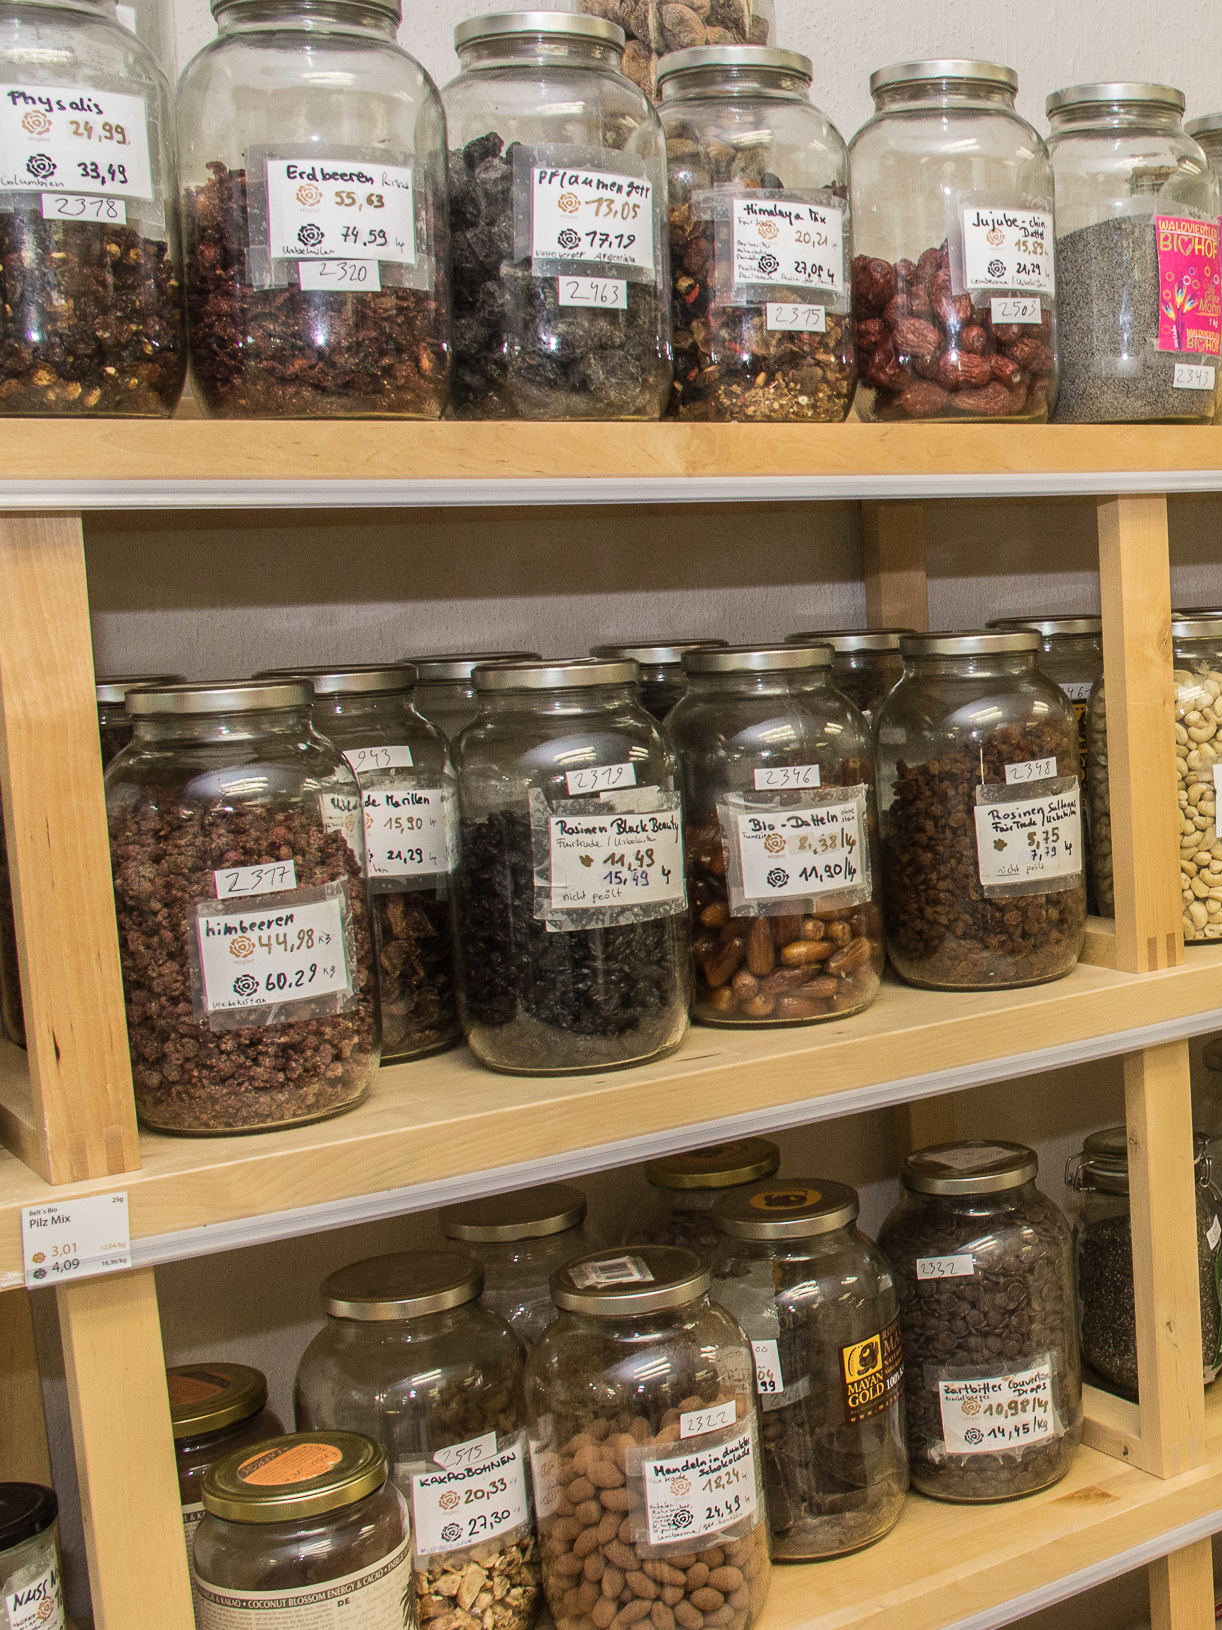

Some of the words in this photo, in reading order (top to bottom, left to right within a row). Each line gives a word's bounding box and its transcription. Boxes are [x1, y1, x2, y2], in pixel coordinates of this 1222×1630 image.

[7, 91, 103, 115] Physalis
[77, 161, 128, 186] 33,49
[286, 164, 374, 185] Erdbeeren
[55, 198, 119, 219] 2378
[334, 190, 384, 211] 55,63
[585, 197, 641, 220] 13,05
[744, 204, 804, 226] Himalaya
[973, 211, 1019, 232] Jujube
[585, 230, 636, 249] 17,19
[795, 230, 827, 248] 20,21
[1159, 220, 1217, 240] WALDVIERTLER
[319, 262, 367, 282] 2320
[566, 281, 619, 304] 2463
[776, 307, 821, 325] 2315
[999, 300, 1036, 316] 2503
[1199, 299, 1220, 314] Mohn
[574, 767, 624, 788] 2319
[766, 767, 810, 785] 2346
[385, 792, 430, 808] Marillen
[988, 806, 1045, 821] Rosinen
[384, 816, 423, 834] 15,90
[555, 820, 608, 836] Rosinen
[611, 817, 647, 835] Black
[649, 814, 680, 843] Beauty
[1027, 827, 1060, 850] 5,75
[387, 848, 423, 864] 21,29
[602, 852, 656, 871] 11,49
[226, 866, 290, 893] 2317
[997, 865, 1020, 875] nicht
[562, 891, 587, 902] nicht
[258, 928, 316, 955] 44,98
[29, 1215, 49, 1229] Pilz
[51, 1213, 71, 1225] Mix
[51, 1242, 78, 1258] 3,01
[52, 1258, 81, 1274] 4,09
[101, 1257, 127, 1267] 16,36/kg
[848, 1370, 883, 1395] MAYAN
[944, 1382, 1002, 1395] Zartbitter
[1013, 1382, 1046, 1396] Drops
[848, 1382, 884, 1407] GOLD
[420, 1452, 516, 1487] KAKAOBOHNEN
[464, 1477, 507, 1504] 20,33
[705, 1495, 741, 1519] 24,49
[468, 1510, 510, 1536] 27,30
[247, 1598, 287, 1609] COCONUT
[287, 1592, 326, 1606] BLOSSOM
[326, 1583, 356, 1600] ENERGY
[363, 1572, 384, 1588] CACAO
